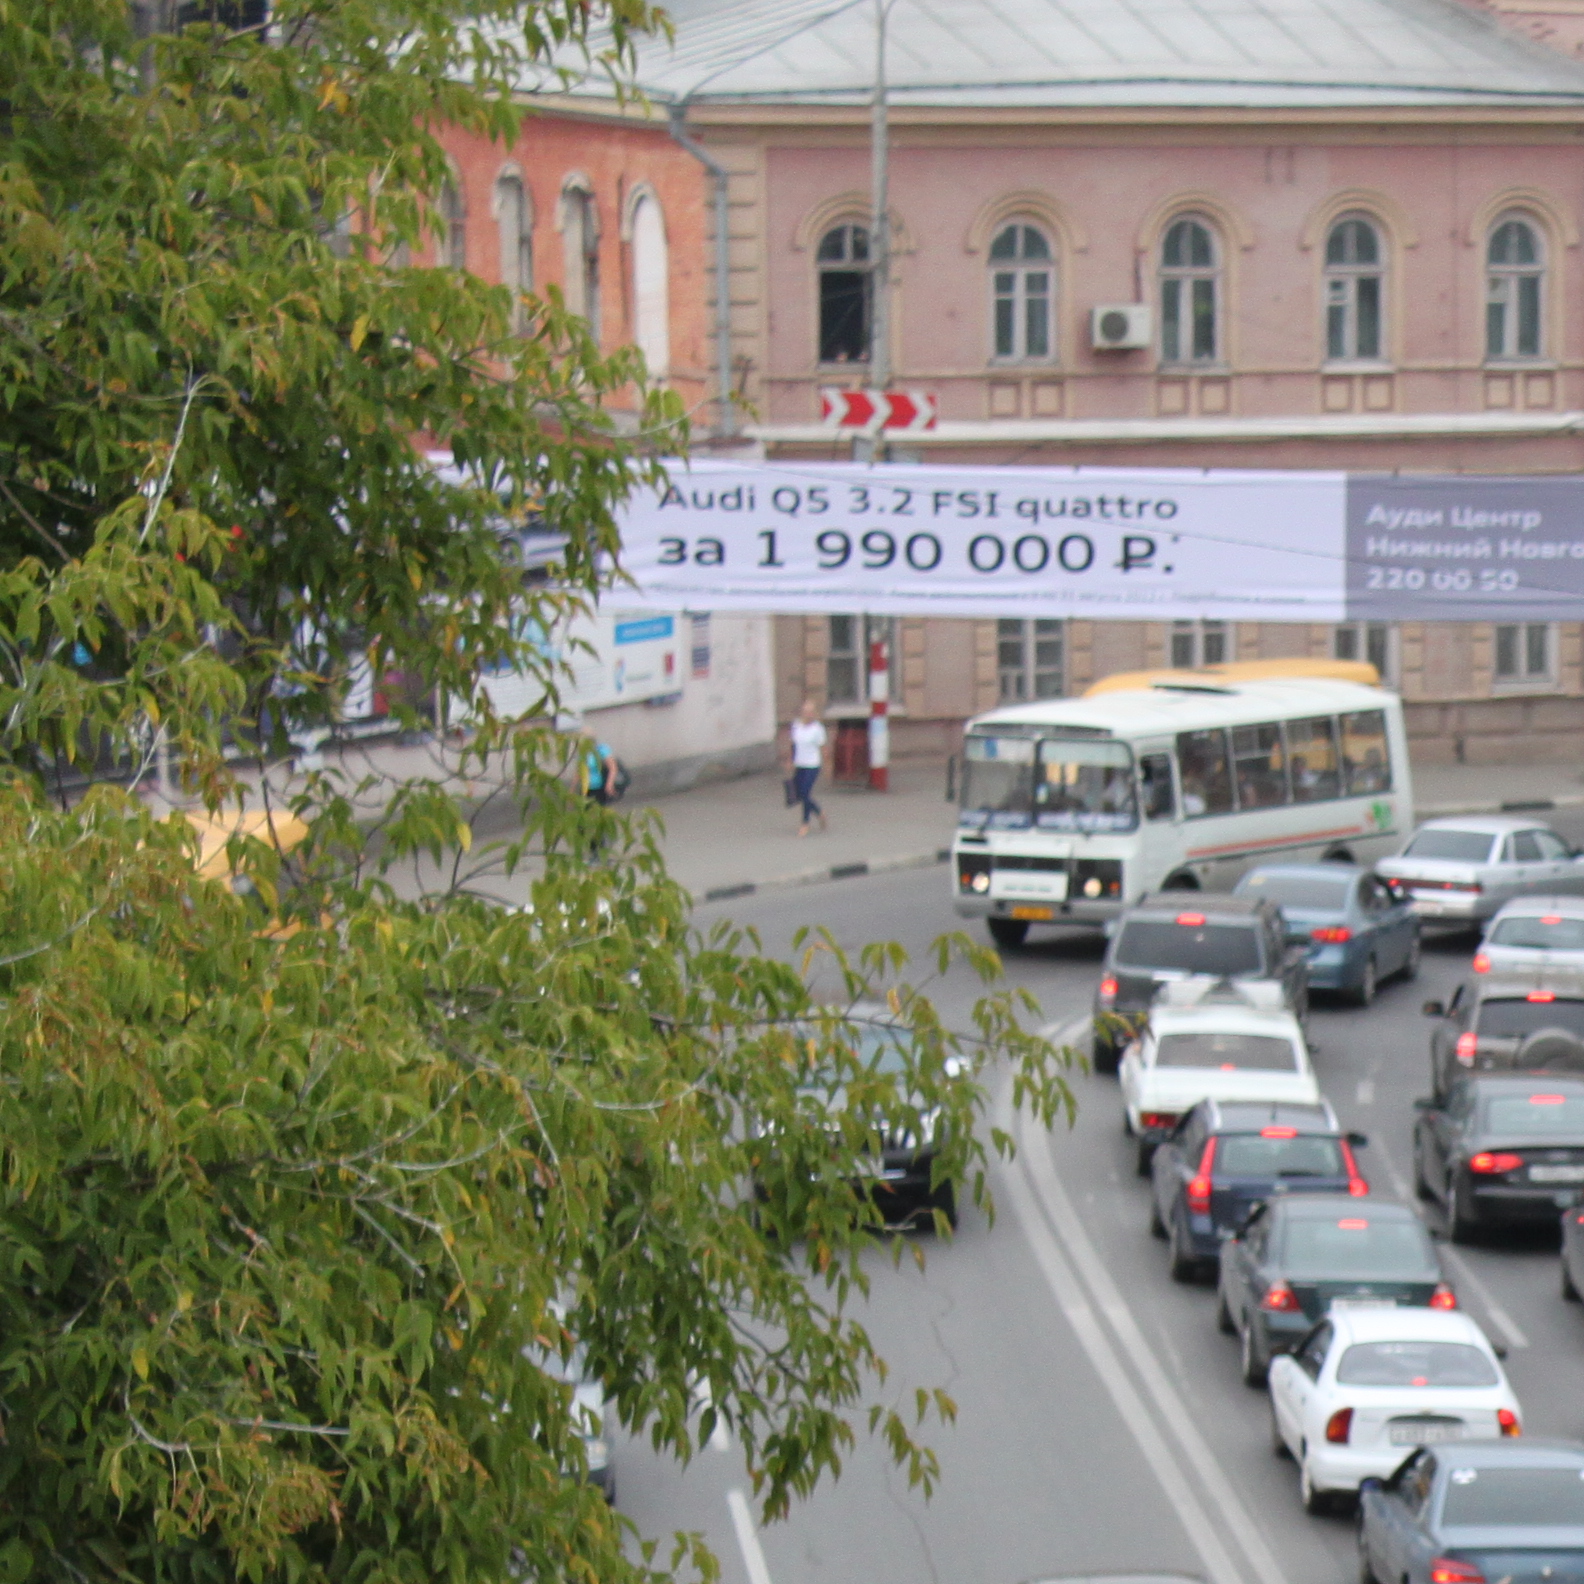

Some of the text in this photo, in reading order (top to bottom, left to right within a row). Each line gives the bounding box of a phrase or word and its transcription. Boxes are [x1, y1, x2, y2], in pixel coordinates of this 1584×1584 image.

[657, 486, 1179, 524] Audi Q5 3.2 FSI quattro
[1365, 504, 1542, 532] Ауди Центр
[657, 536, 727, 568] за
[756, 530, 786, 569] 1
[815, 530, 943, 573] 990
[966, 534, 1095, 574] 000
[1365, 534, 1491, 560] Нижний
[1366, 567, 1425, 591] 220
